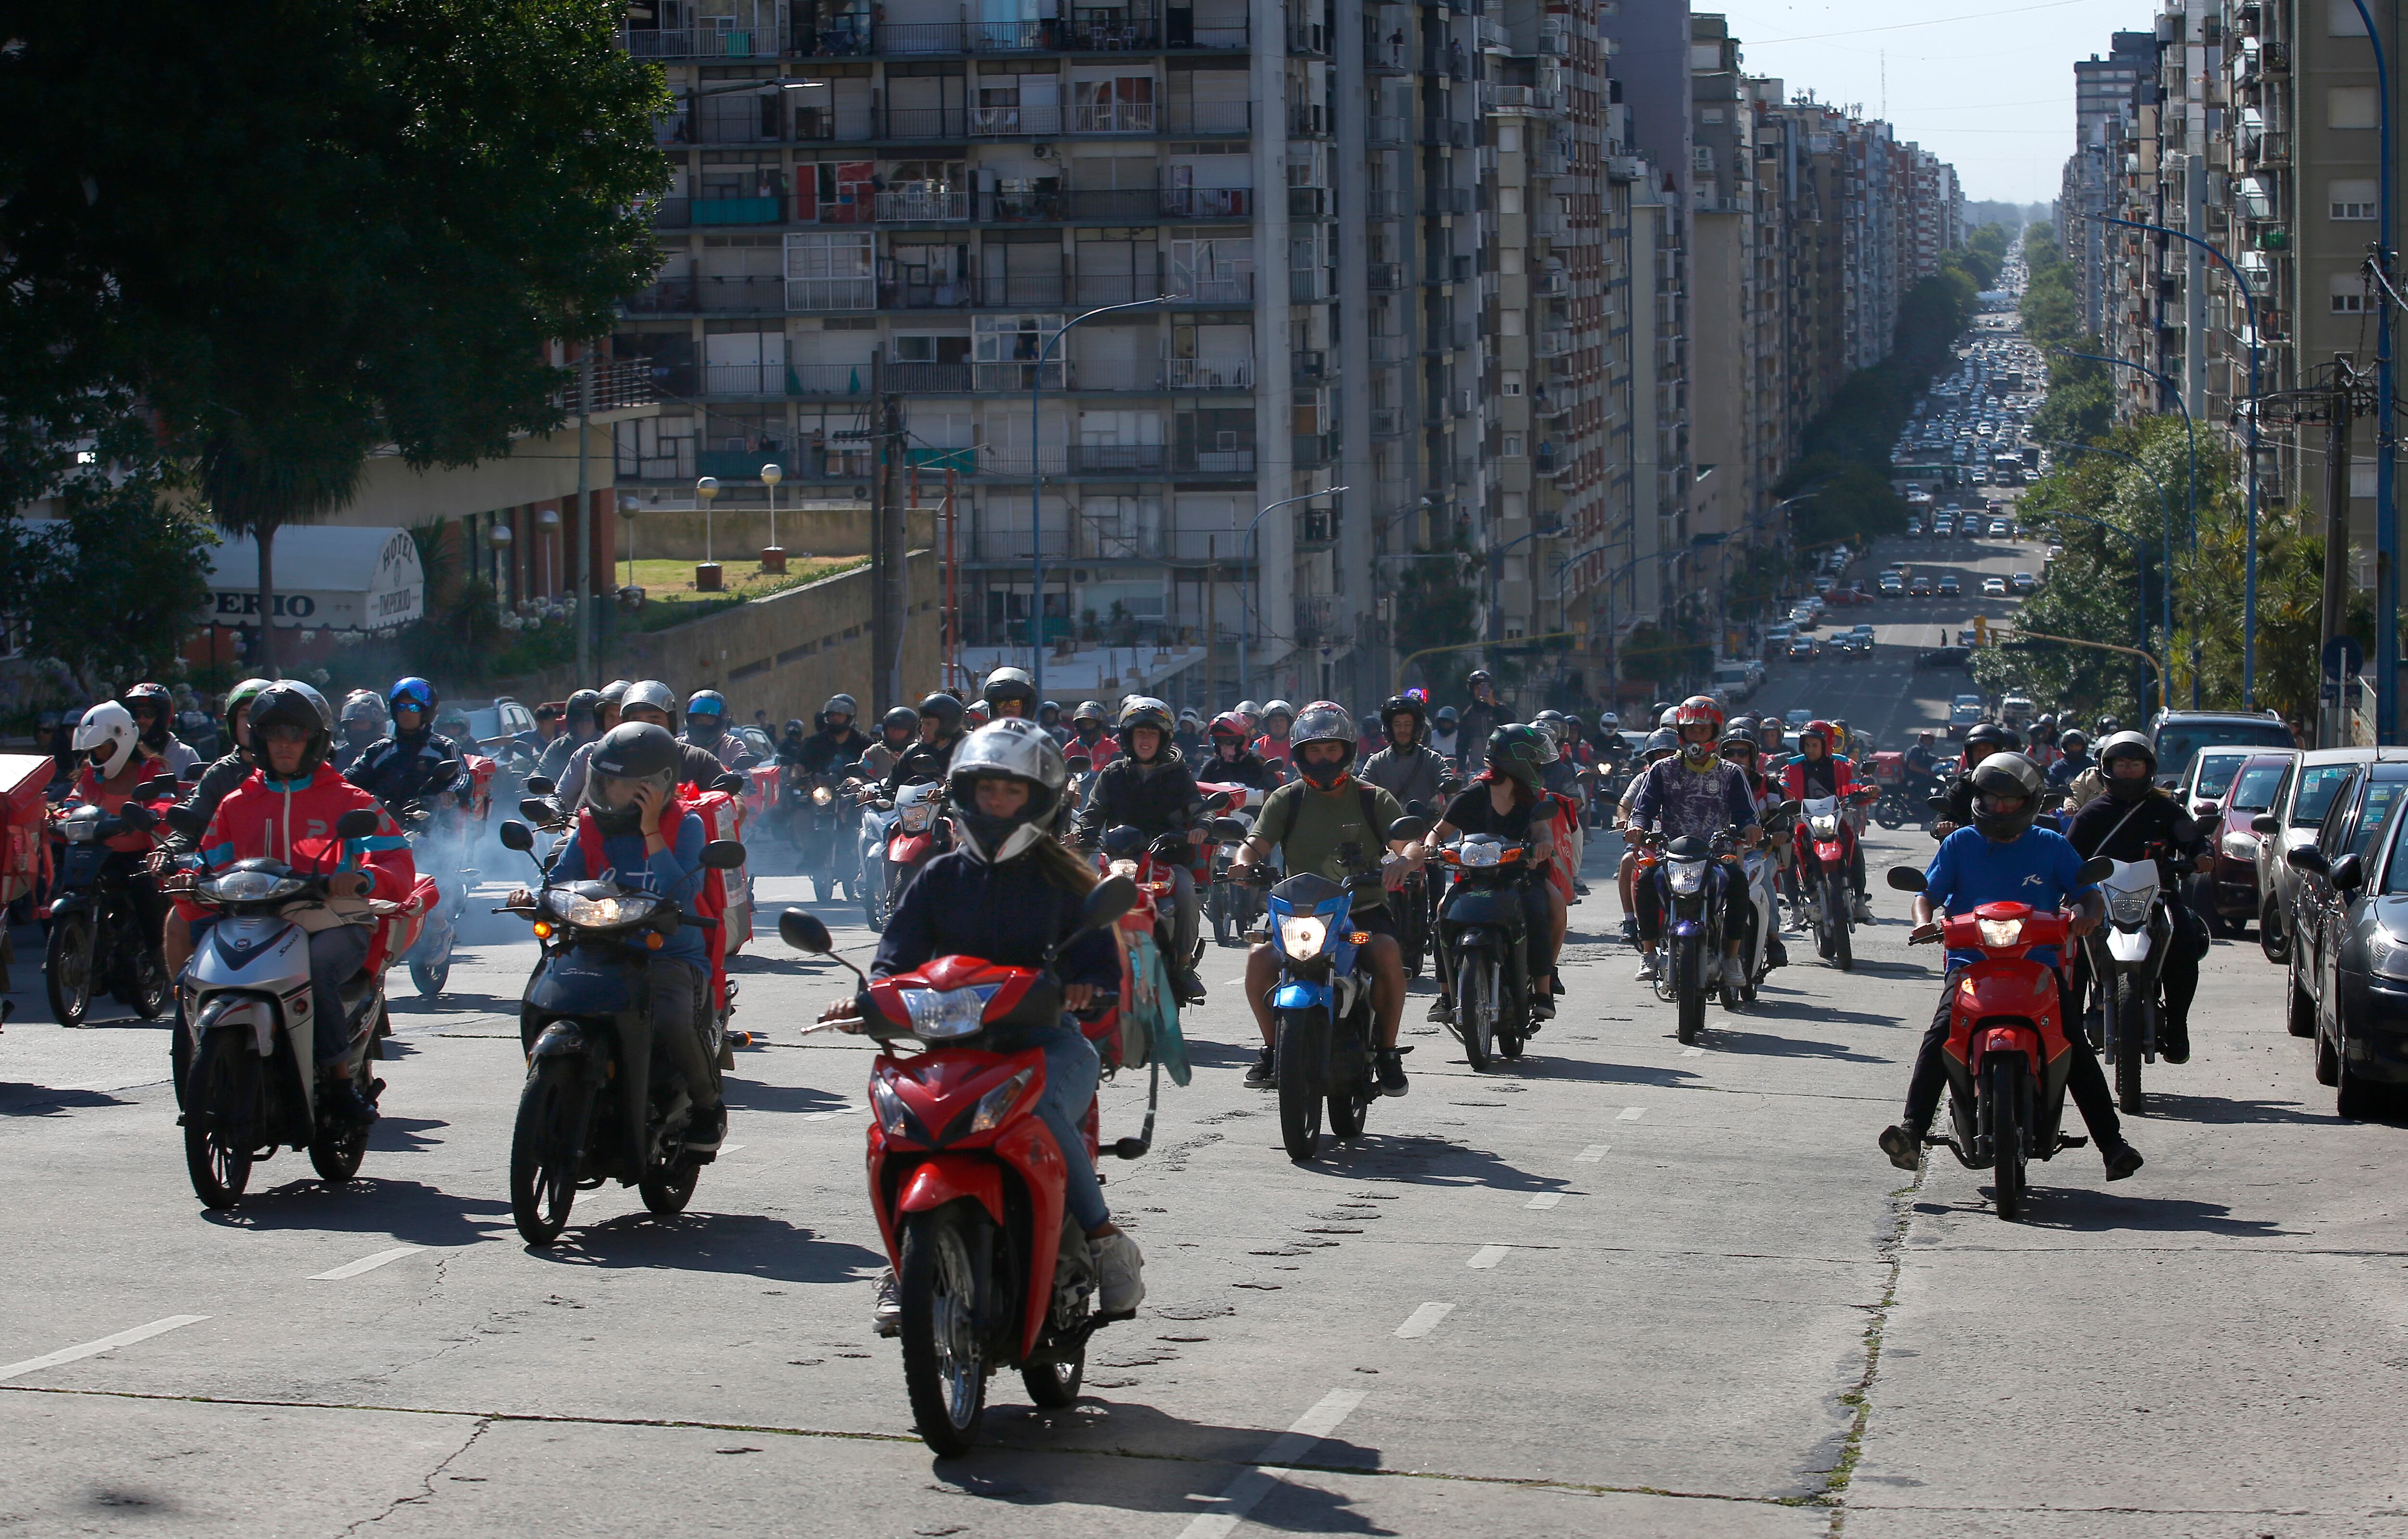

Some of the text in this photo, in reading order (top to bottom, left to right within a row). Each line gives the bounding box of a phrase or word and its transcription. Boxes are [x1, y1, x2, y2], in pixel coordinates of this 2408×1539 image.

[383, 533, 413, 572] HOTEL
[380, 588, 410, 617] IMPERIO
[560, 967, 604, 977] Siam
